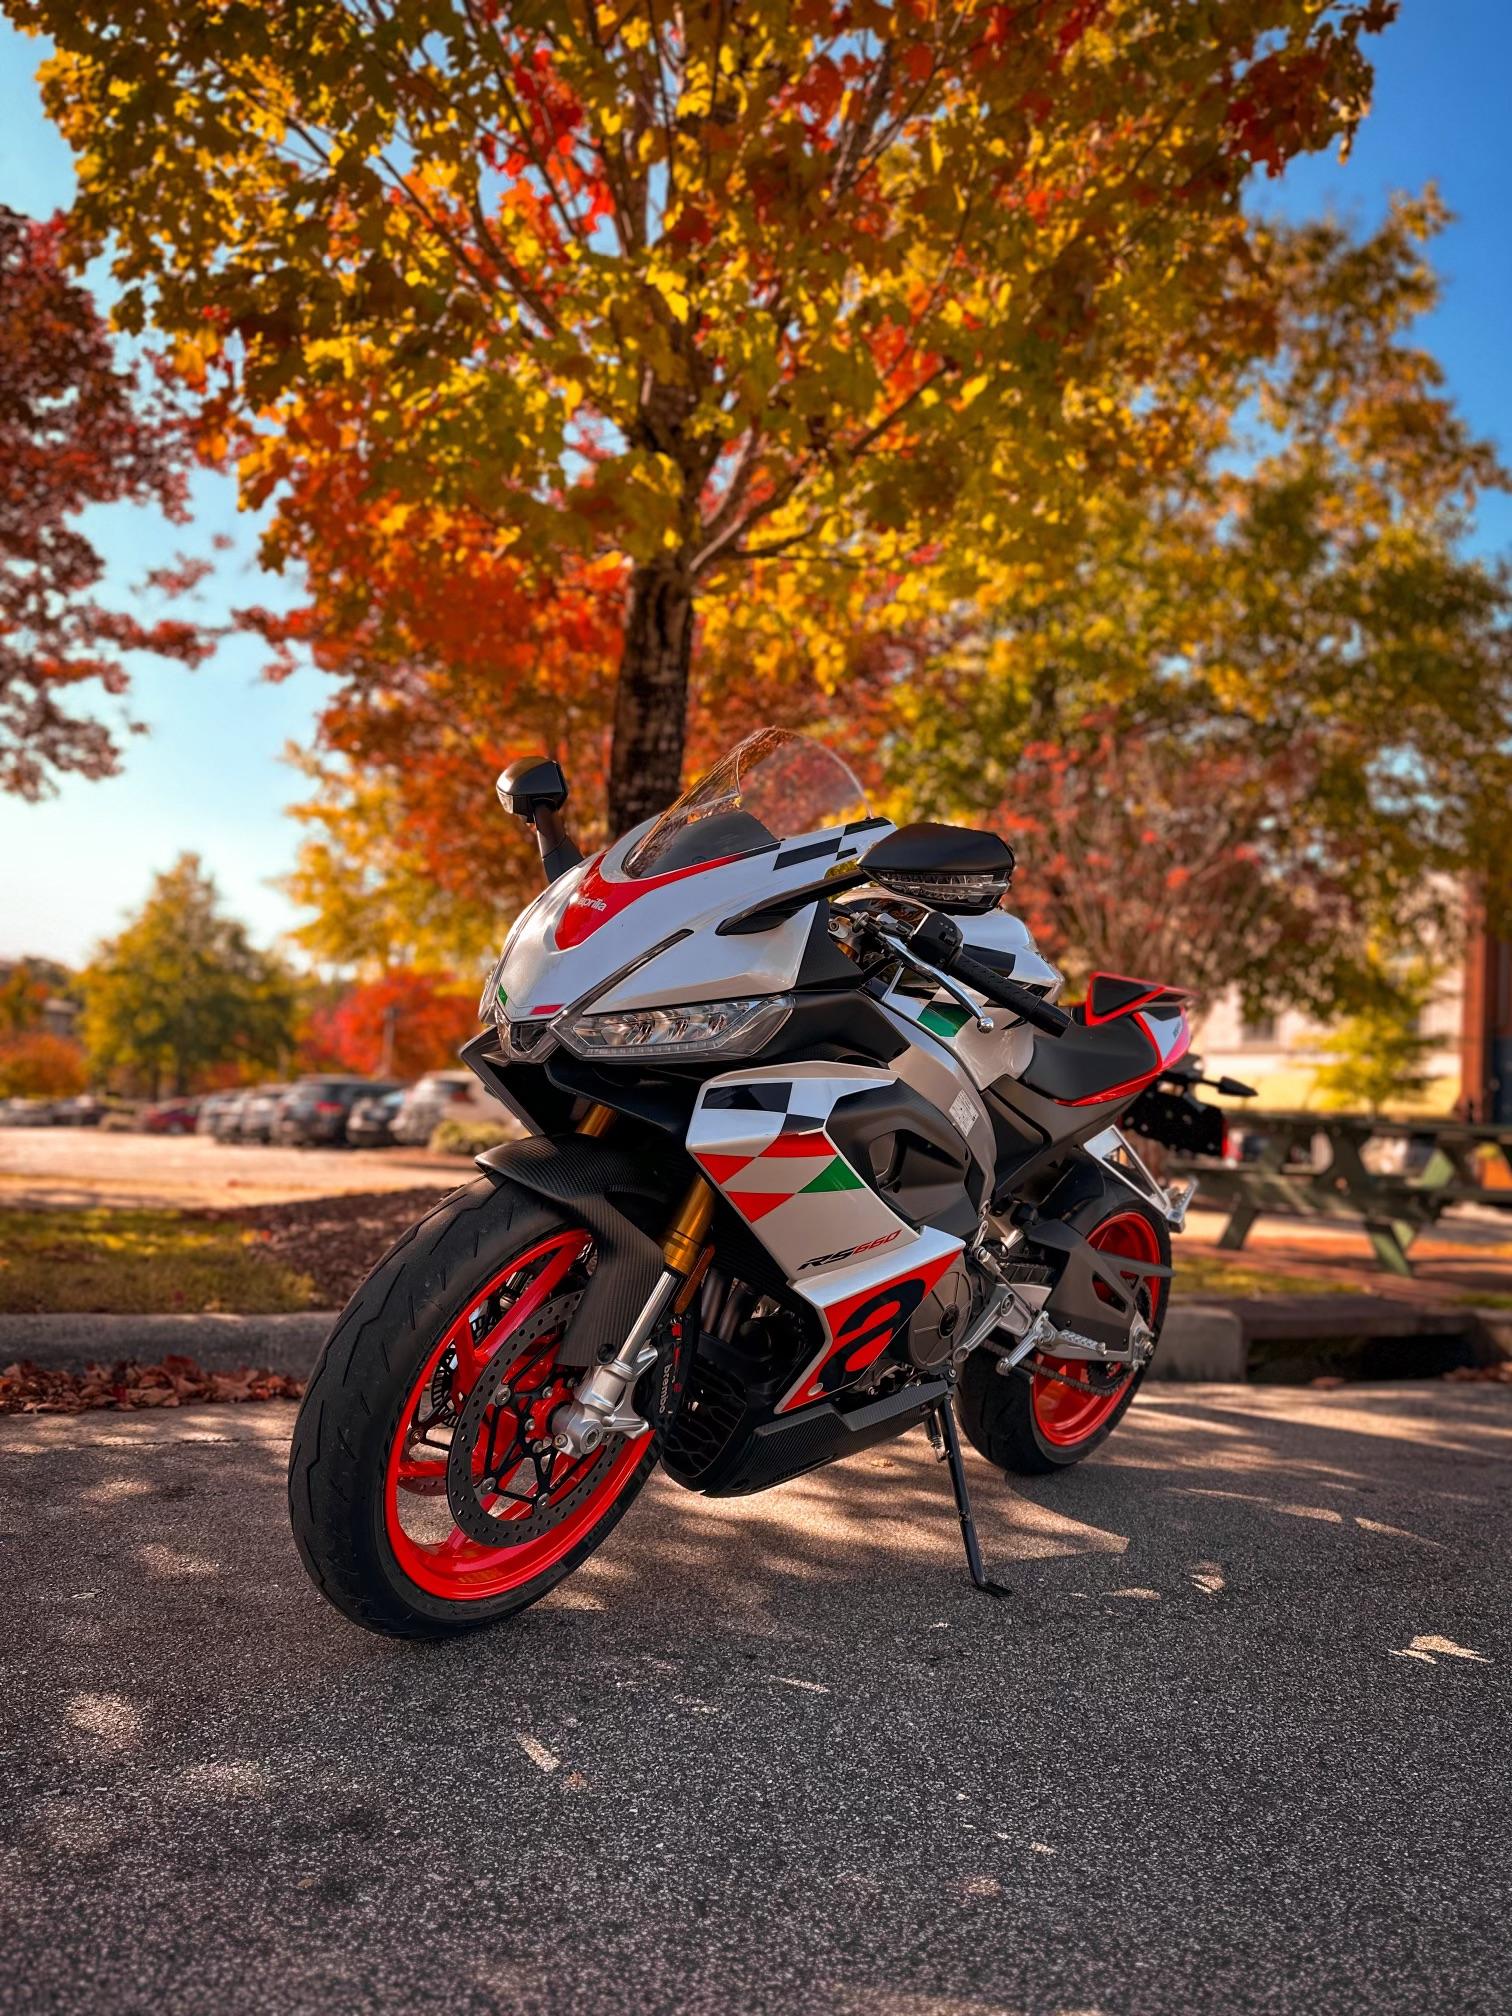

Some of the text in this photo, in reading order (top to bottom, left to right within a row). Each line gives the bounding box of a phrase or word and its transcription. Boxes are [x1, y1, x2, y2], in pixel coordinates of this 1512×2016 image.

[577, 897, 607, 912] aprilia
[797, 1229, 902, 1271] RS660
[659, 1363, 673, 1414] brembo
